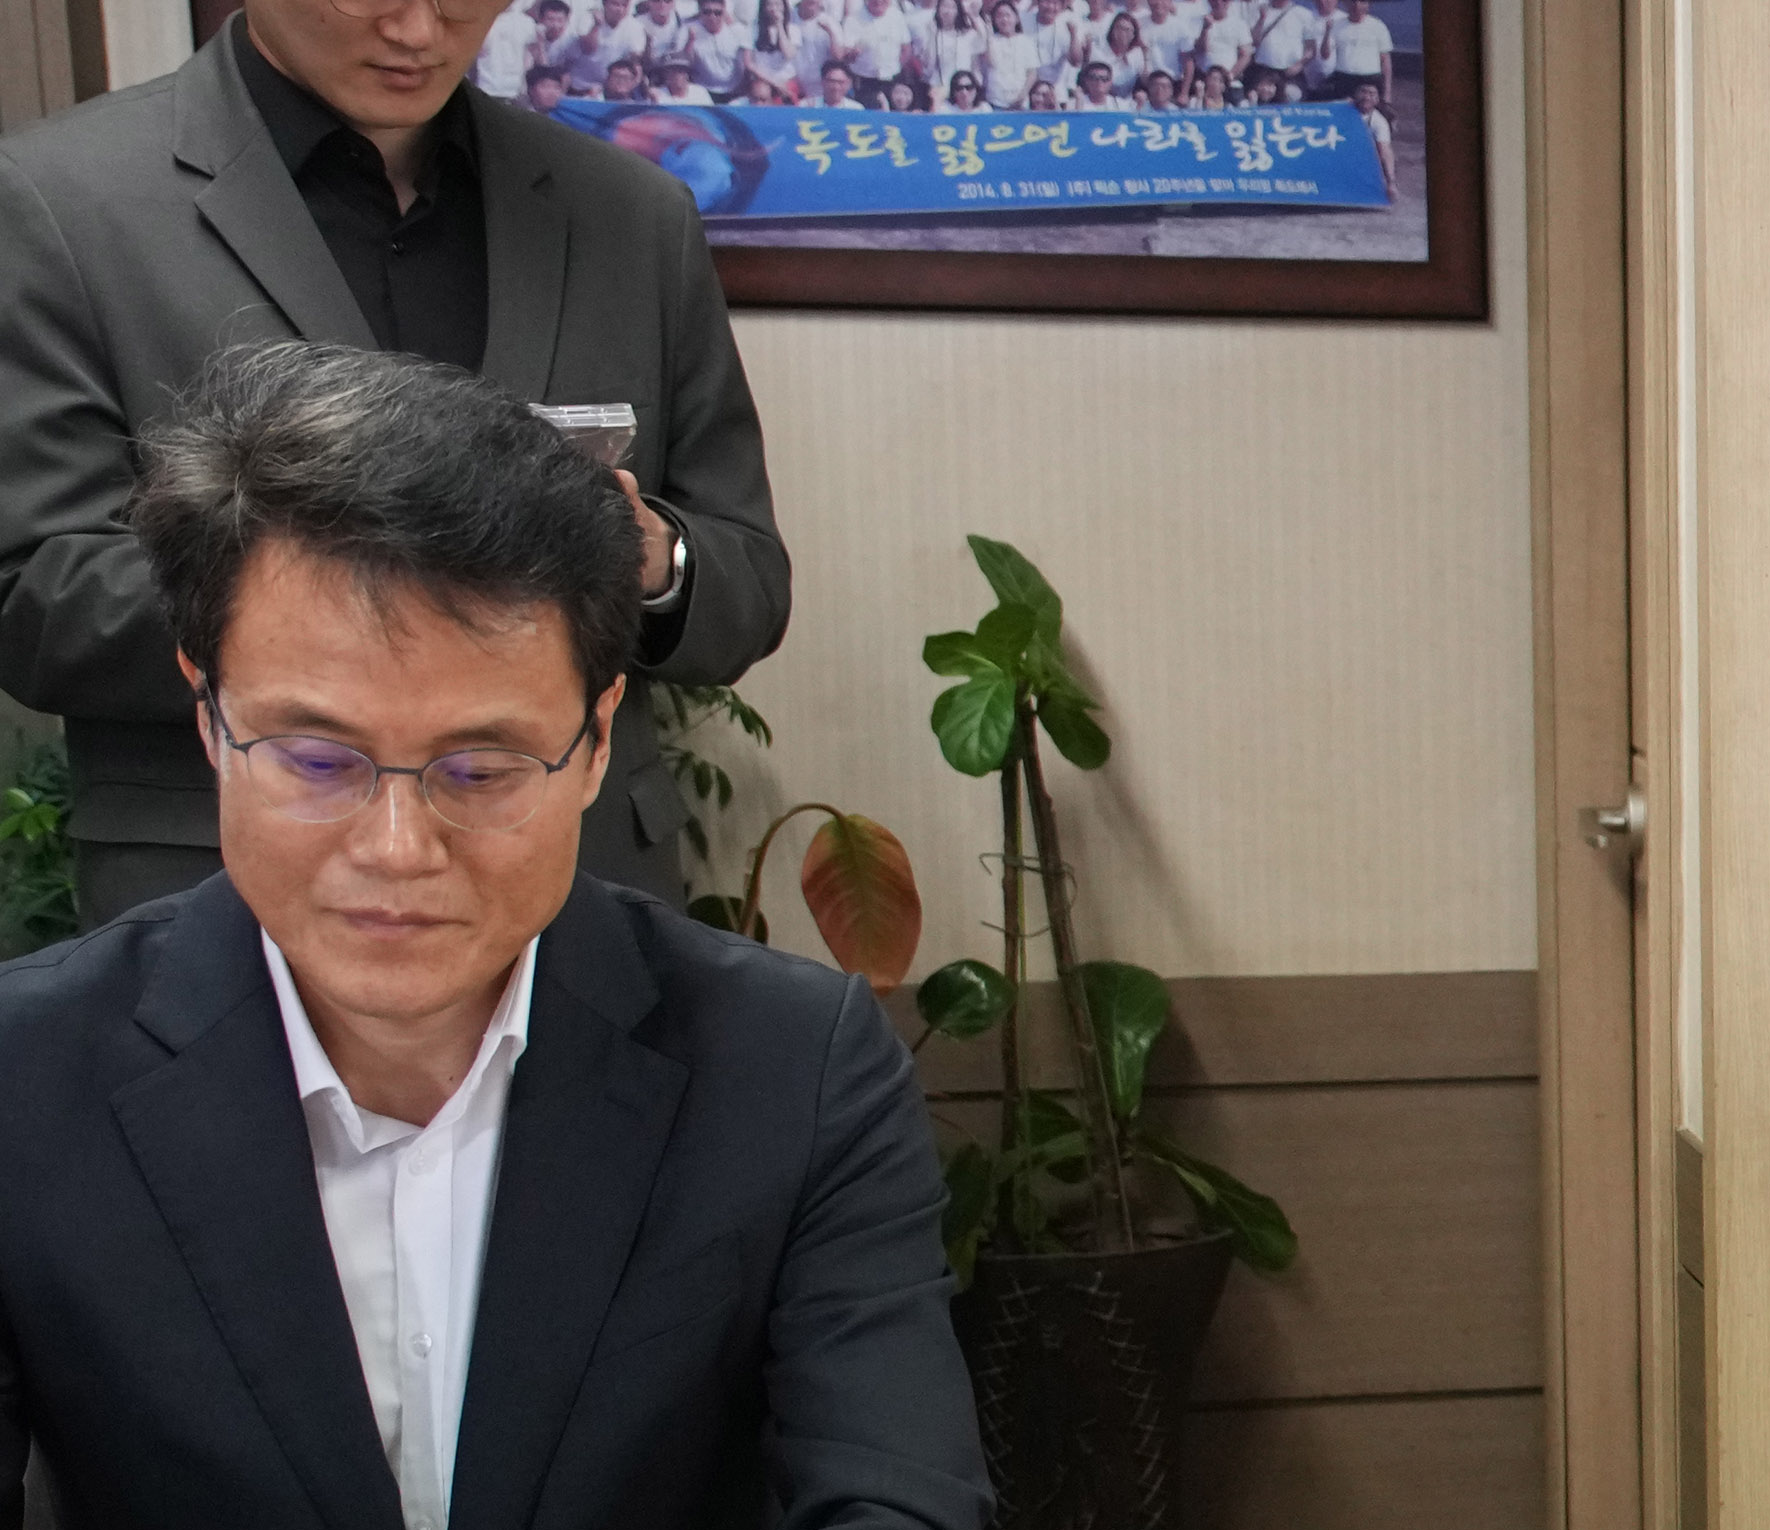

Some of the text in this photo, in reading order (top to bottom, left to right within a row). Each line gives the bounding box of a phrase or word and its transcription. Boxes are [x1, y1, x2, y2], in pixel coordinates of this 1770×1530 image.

[796, 120, 919, 175] 독도를
[1091, 119, 1218, 161] 나라를
[1224, 117, 1345, 172] 잃는다
